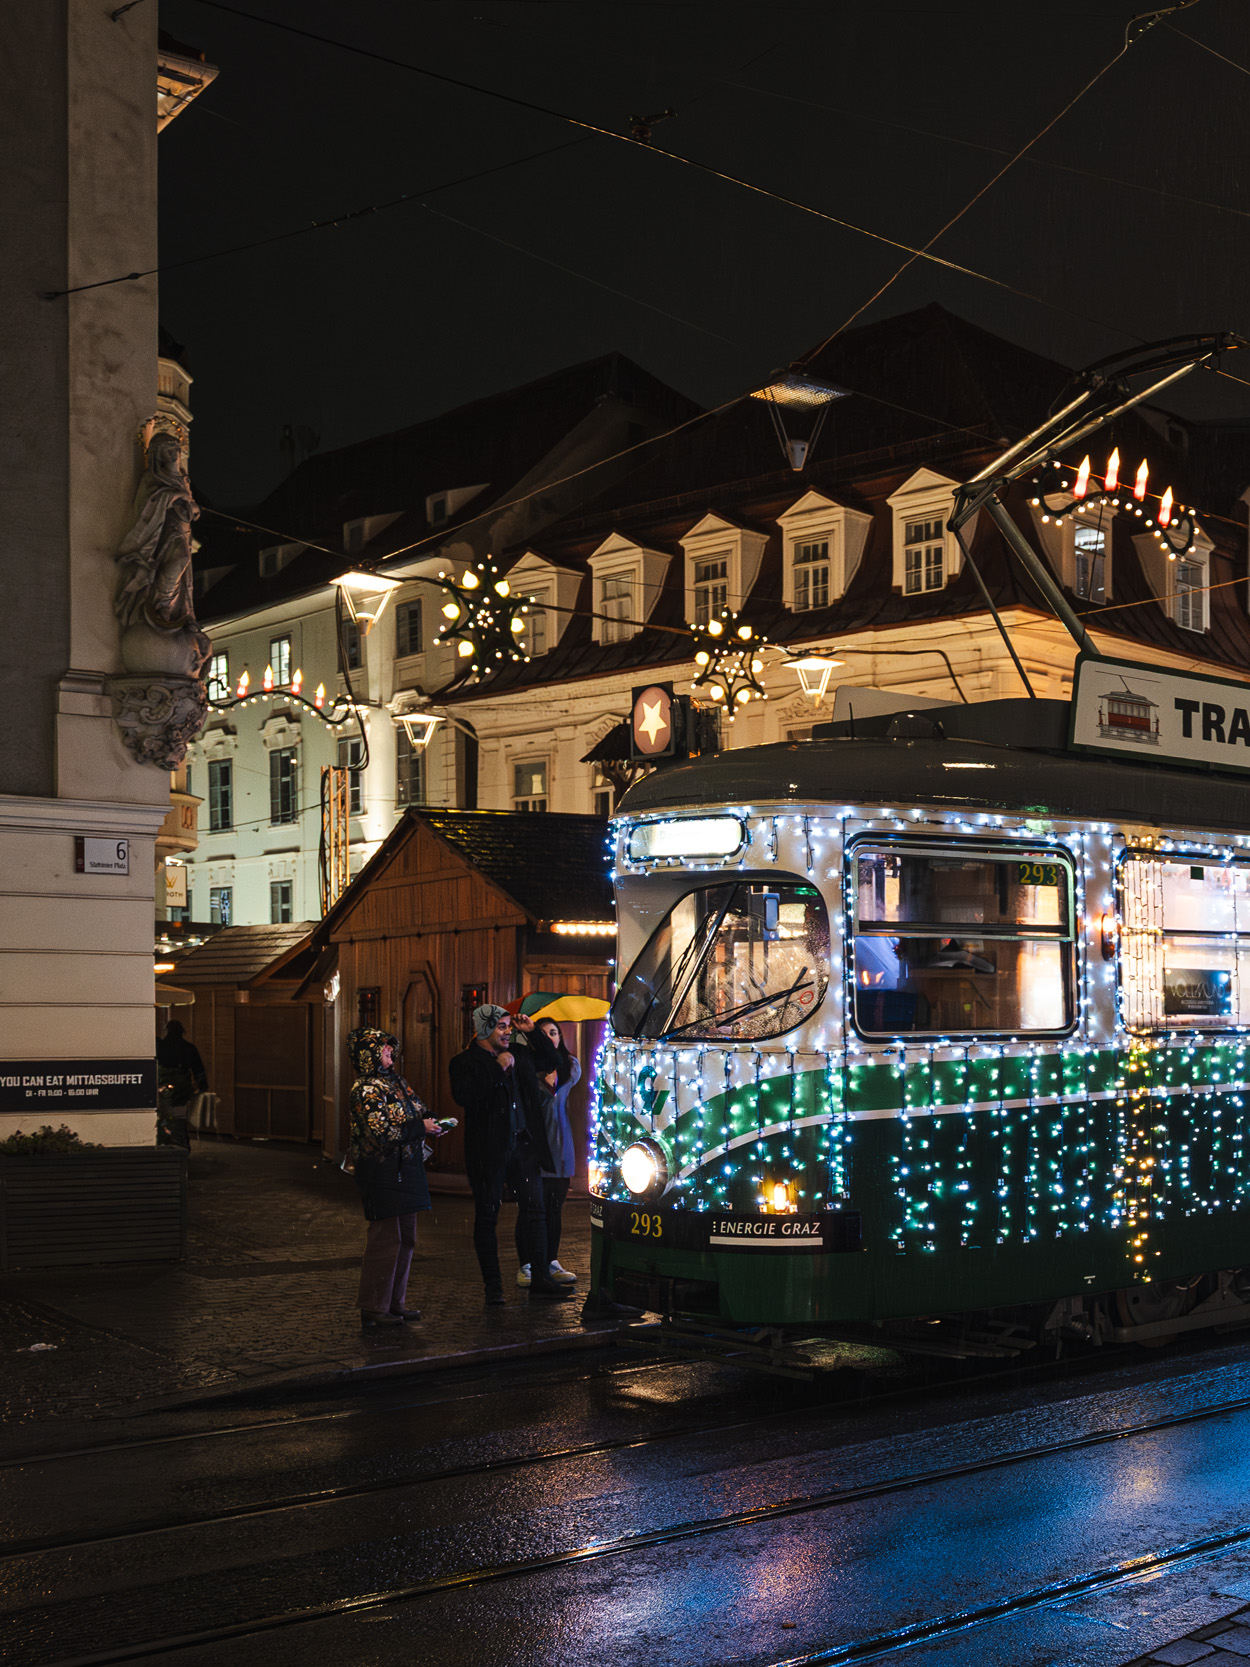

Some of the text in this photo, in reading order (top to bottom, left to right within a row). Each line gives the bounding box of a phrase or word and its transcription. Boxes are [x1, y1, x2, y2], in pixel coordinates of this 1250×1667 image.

[116, 841, 127, 860] 6
[1020, 863, 1058, 885] 293
[0, 1074, 143, 1087] YOU CAN EAT MITTAGSBUFFET
[630, 1212, 663, 1238] 293
[720, 1221, 821, 1235] ENERGIE GRAZ
